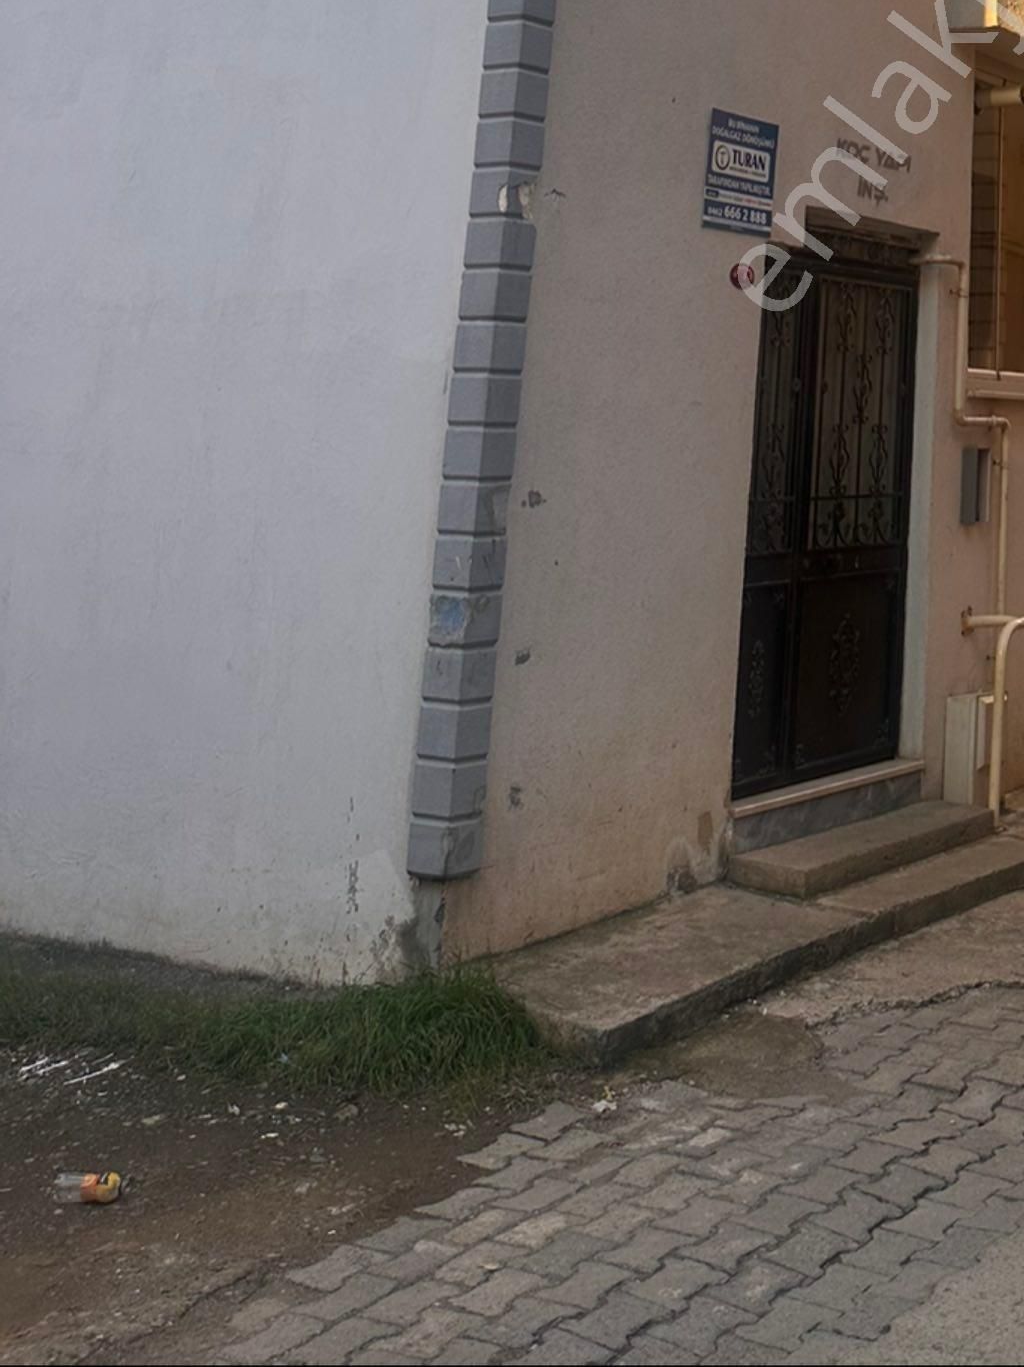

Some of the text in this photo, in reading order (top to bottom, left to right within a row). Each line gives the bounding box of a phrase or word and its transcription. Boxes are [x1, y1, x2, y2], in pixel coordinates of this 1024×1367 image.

[732, 148, 767, 171] TURAN
[724, 205, 742, 221] 666
[742, 208, 749, 222] 2
[750, 209, 767, 225] 888
